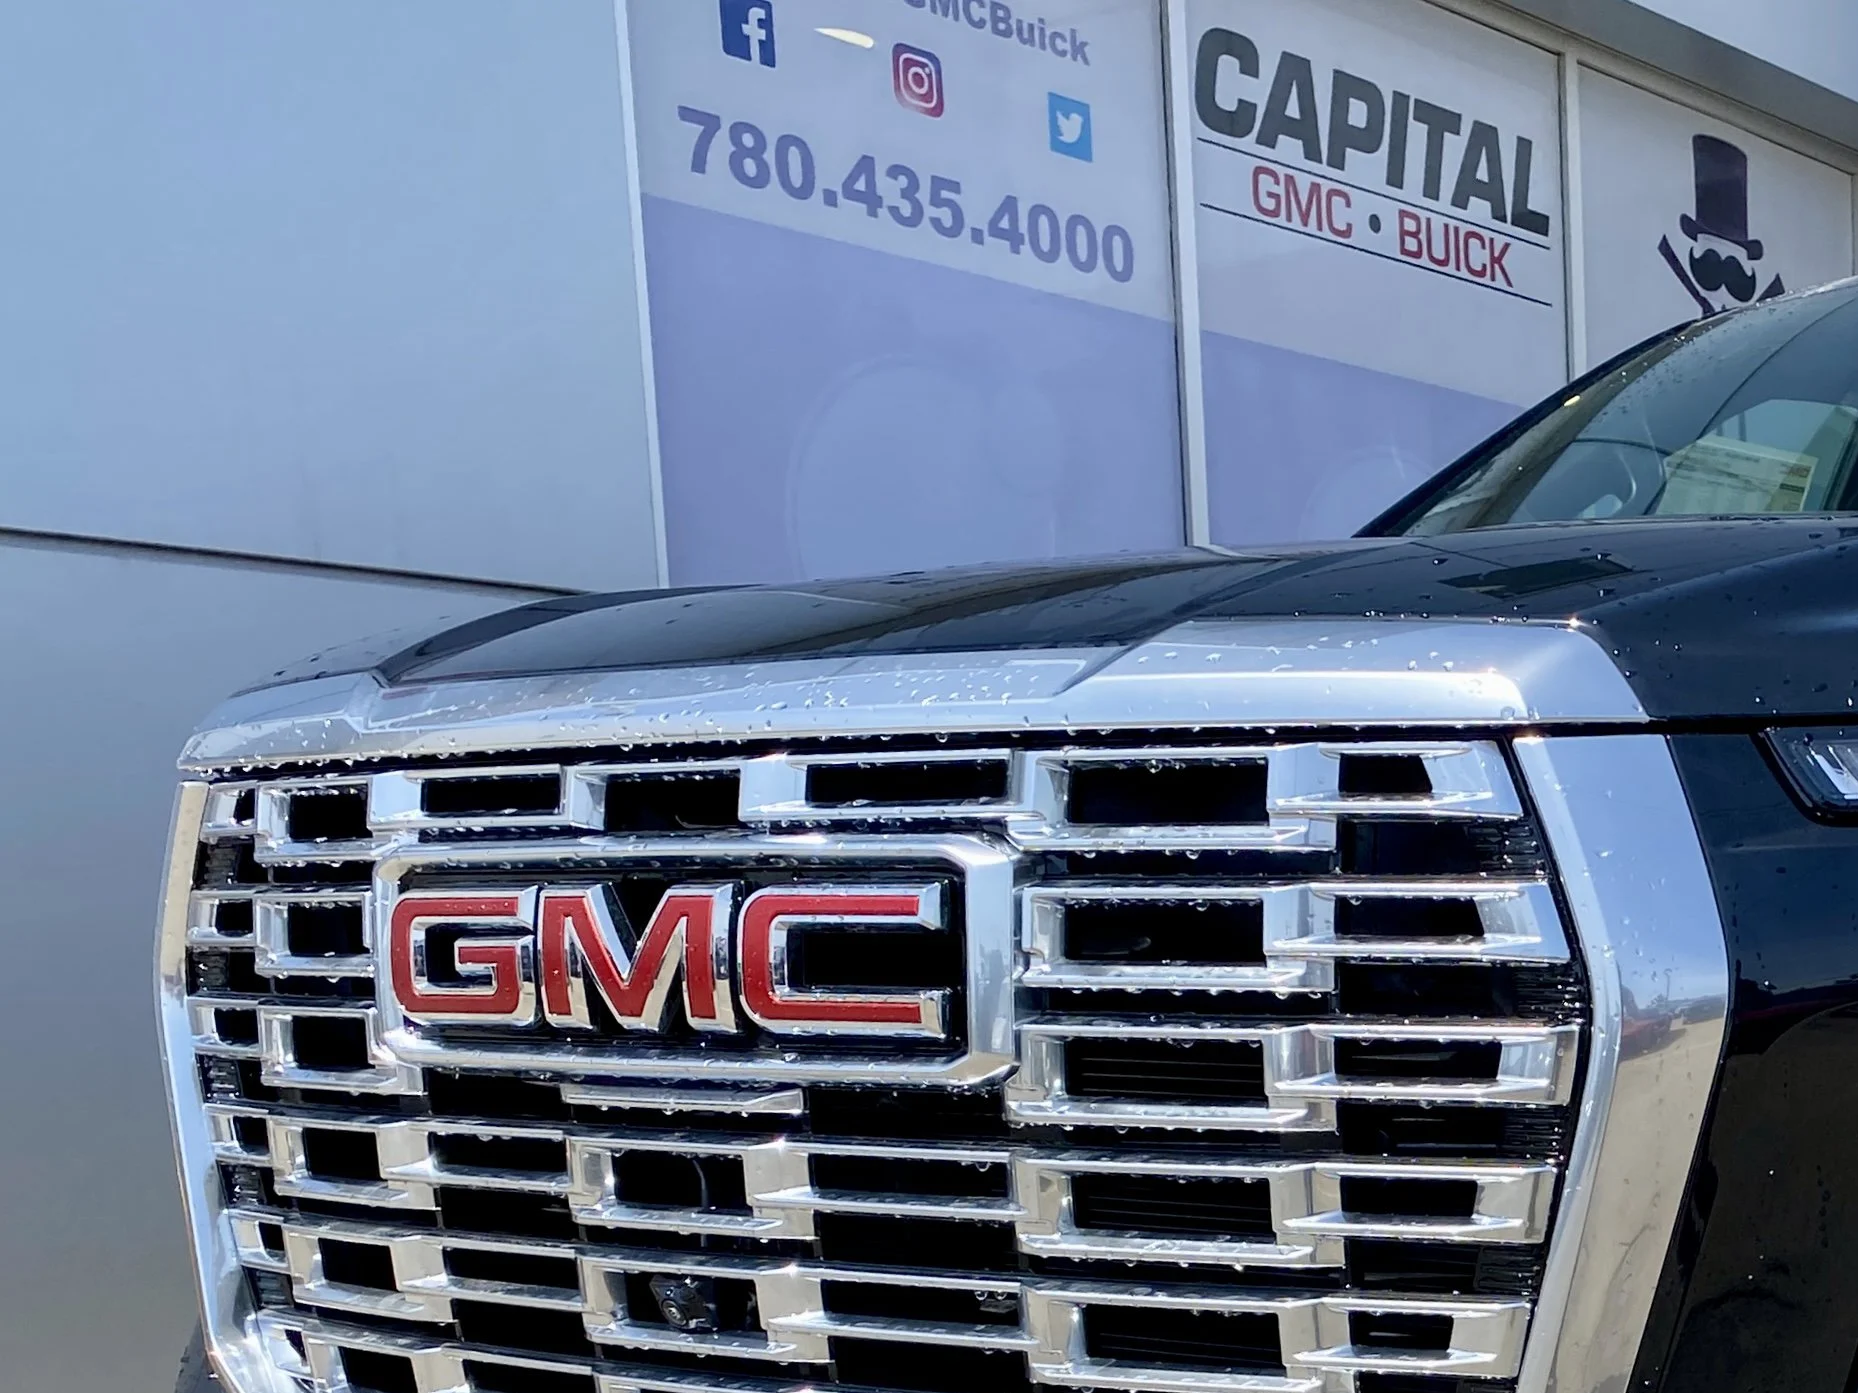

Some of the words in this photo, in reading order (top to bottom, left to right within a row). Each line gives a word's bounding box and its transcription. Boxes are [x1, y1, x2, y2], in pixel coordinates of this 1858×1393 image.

[905, 0, 1091, 66] MCBuick
[677, 105, 1134, 283] 780.435.4000
[1194, 27, 1550, 237] CAPITAL
[1251, 166, 1353, 240] GMC
[1399, 210, 1514, 288] BUICK
[390, 881, 951, 1039] GMC
